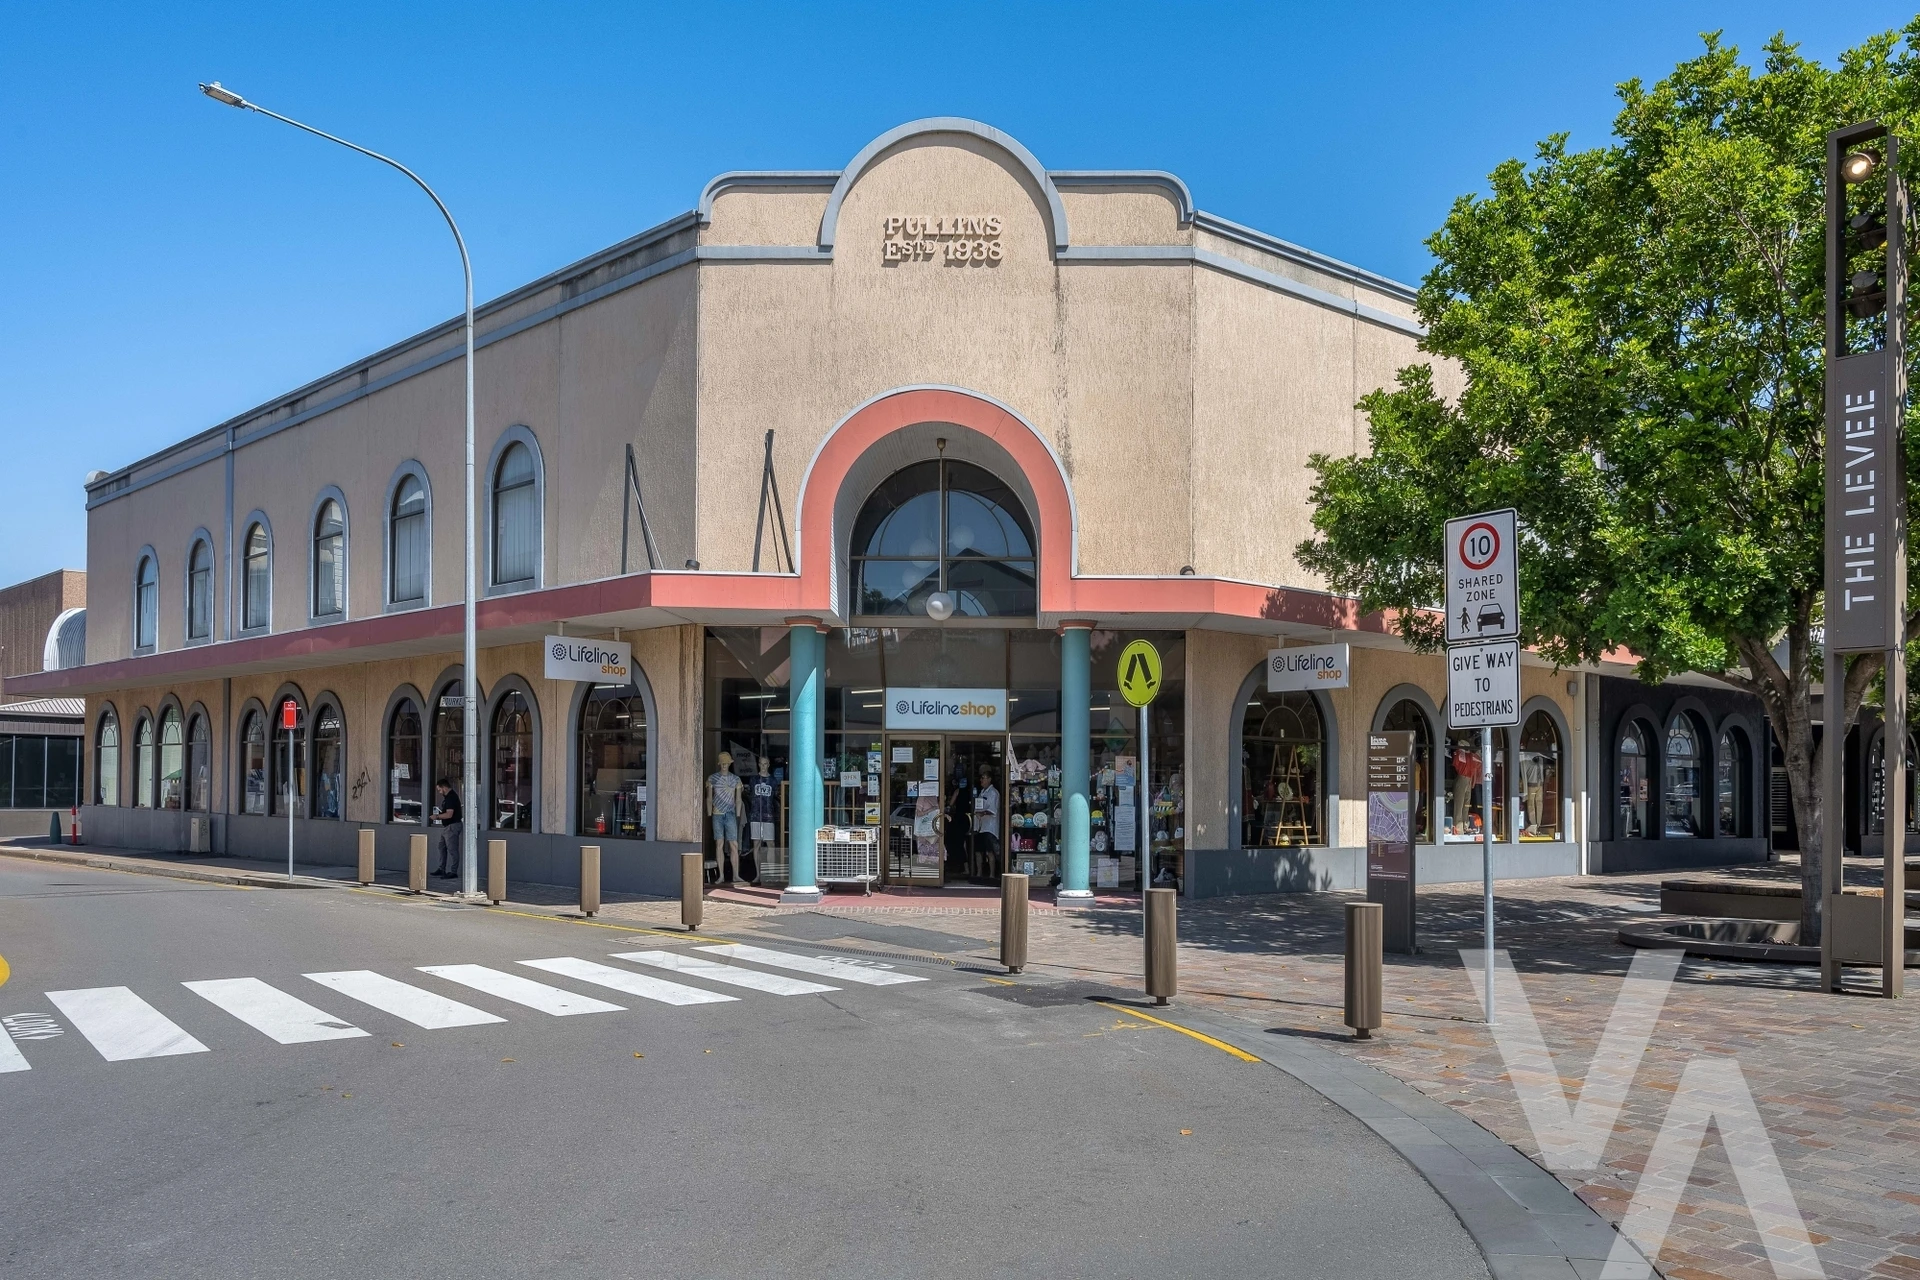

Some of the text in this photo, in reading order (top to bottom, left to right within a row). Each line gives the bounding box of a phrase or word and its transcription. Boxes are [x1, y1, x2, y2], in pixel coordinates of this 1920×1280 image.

[884, 215, 1002, 237] PULLINS
[945, 240, 1003, 262] 1938
[1845, 390, 1875, 610] THE LEVEE
[1470, 535, 1491, 557] 10
[1458, 573, 1503, 589] SHARED
[1466, 588, 1495, 602] ZONE
[569, 645, 619, 665] Lifeline
[1287, 654, 1335, 671] Lifeline
[1453, 651, 1514, 671] GIVE WAY
[601, 664, 627, 677] shop
[1317, 669, 1342, 680] shop
[1475, 677, 1490, 693] TO
[1454, 699, 1513, 718] PEDESTRIANS
